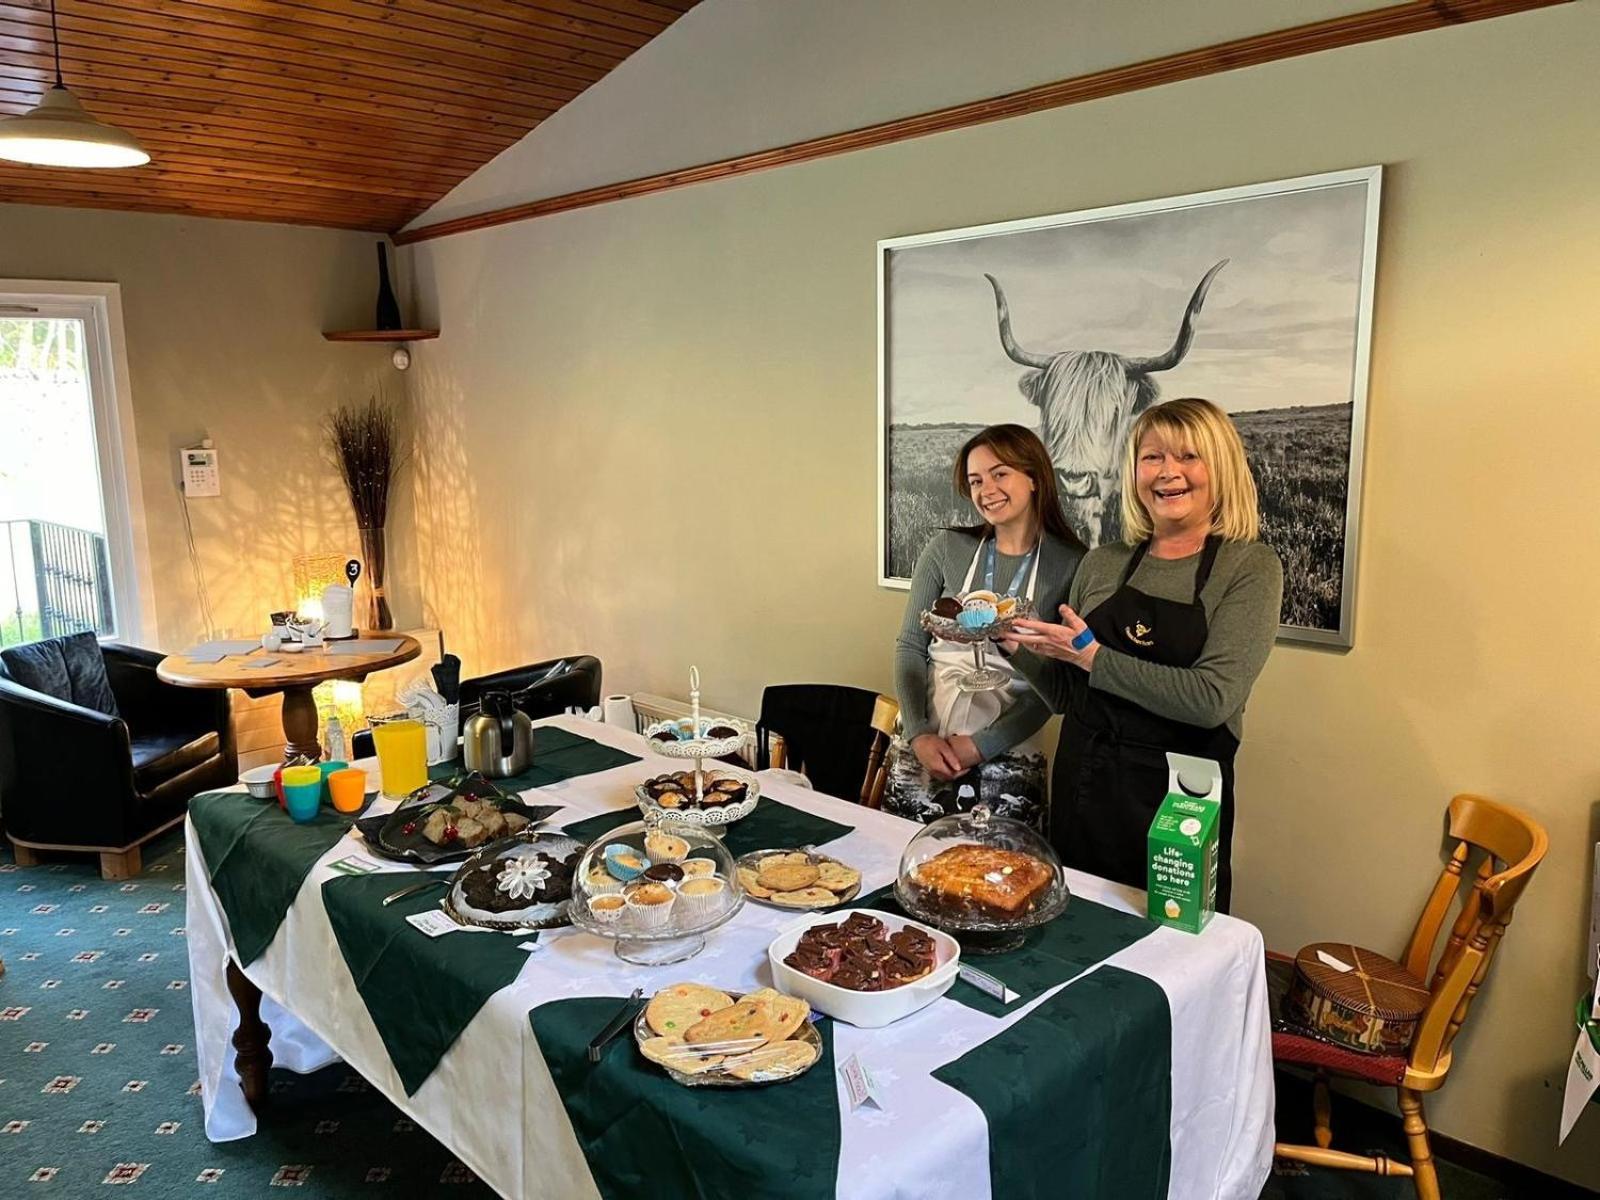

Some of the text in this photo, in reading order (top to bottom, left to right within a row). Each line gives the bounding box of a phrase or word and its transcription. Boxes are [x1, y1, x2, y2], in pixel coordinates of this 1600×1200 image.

[349, 563, 358, 576] 3
[1163, 847, 1183, 857] Life-
[1153, 854, 1194, 871] changing
[1152, 862, 1195, 879] donations
[1156, 873, 1190, 886] go here
